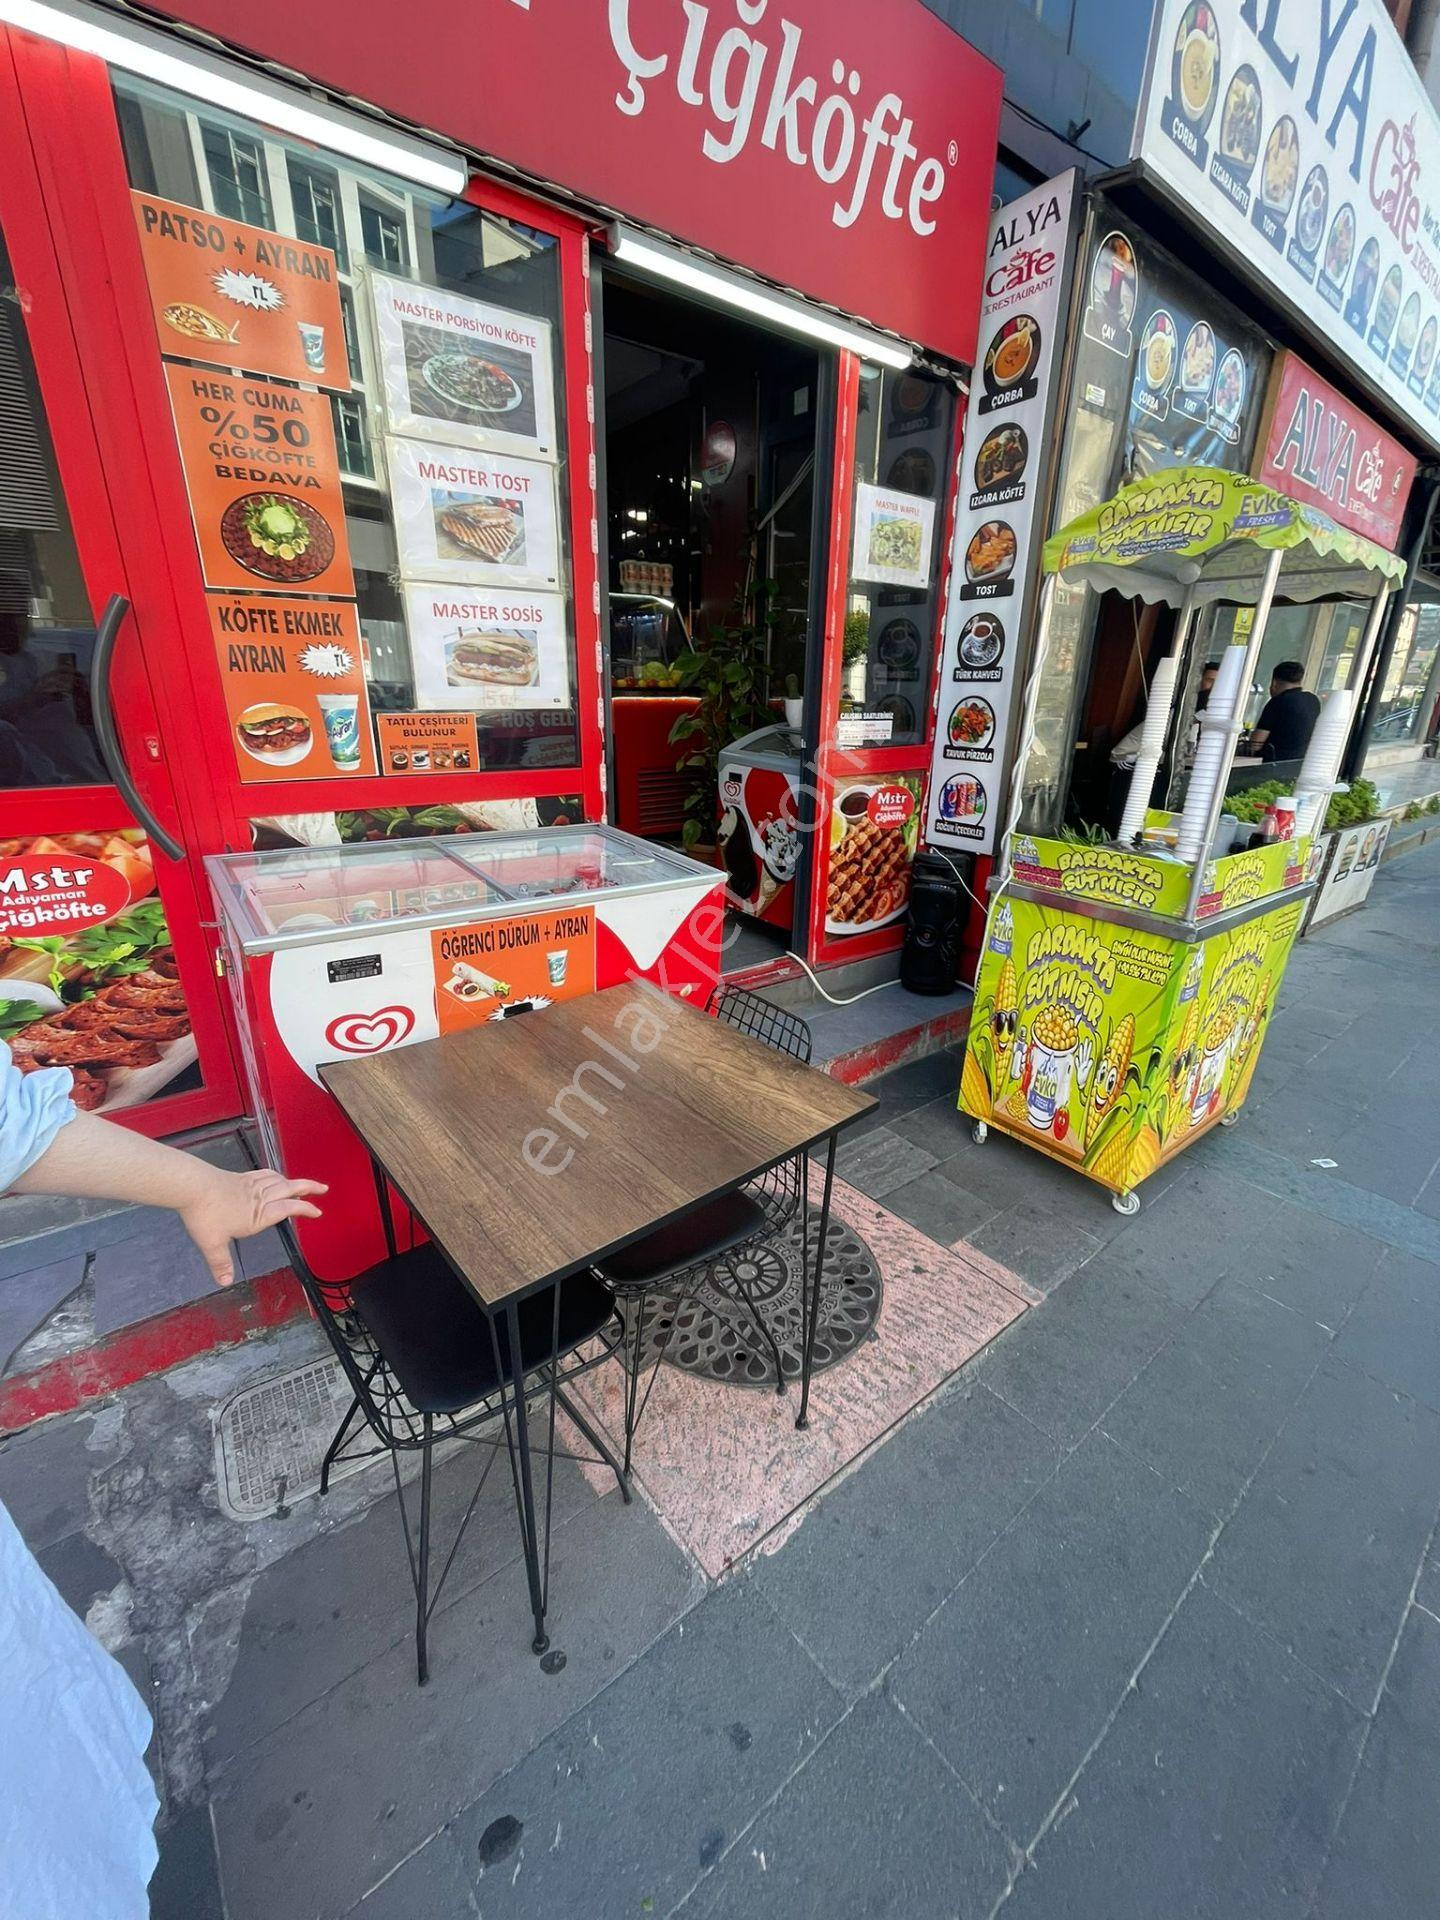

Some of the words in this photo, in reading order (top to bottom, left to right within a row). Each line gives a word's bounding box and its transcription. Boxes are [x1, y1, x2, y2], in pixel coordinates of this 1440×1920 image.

[1172, 116, 1198, 156] ÇORBA
[989, 196, 1061, 258] ALYA
[1263, 214, 1277, 238] TOST
[142, 205, 225, 253] PATSO
[255, 239, 330, 283] AYRAN
[985, 247, 1056, 298] Cafe
[991, 276, 1056, 313] RESTAURANT
[393, 299, 444, 323] MASTER
[446, 311, 502, 339] PORSİYON
[504, 328, 537, 349] KÖFTE
[1101, 323, 1117, 341] ÇAY
[192, 379, 236, 403] HER
[243, 389, 304, 414] CUMA
[991, 387, 1024, 410] ÇORBA
[1138, 390, 1160, 412] ÇORBA
[1183, 397, 1197, 414] TOST
[199, 406, 310, 448] %50
[208, 440, 316, 469] ÇİĞKÖFTE
[1272, 387, 1357, 508] ALYA
[215, 464, 322, 489] BEDAVA
[418, 461, 488, 488] MASTER
[492, 473, 531, 494] TOST
[875, 499, 899, 514] MASTER
[971, 491, 998, 507] IZGARA
[999, 486, 1024, 501] KÖFTE
[975, 584, 997, 597] TOST
[218, 601, 279, 634] KÖFTE
[284, 607, 344, 637] EKMEK
[432, 602, 498, 621] MASTER
[502, 604, 543, 623] SOSİS
[228, 644, 287, 674] AYRAN
[955, 669, 972, 680] TÜRK
[386, 717, 416, 727] TATLI
[420, 715, 469, 728] ÇEŞİTLERİ
[403, 728, 456, 738] BULUNUR
[877, 791, 908, 805] Mstr
[1057, 850, 1163, 890] BARDAKTA
[2, 889, 87, 906] Adıyaman
[440, 924, 496, 960] ÖĞRENCİ
[499, 919, 541, 951] DÜRÜM
[554, 915, 589, 941] AYRAN
[1027, 924, 1117, 990] BARDAKTA
